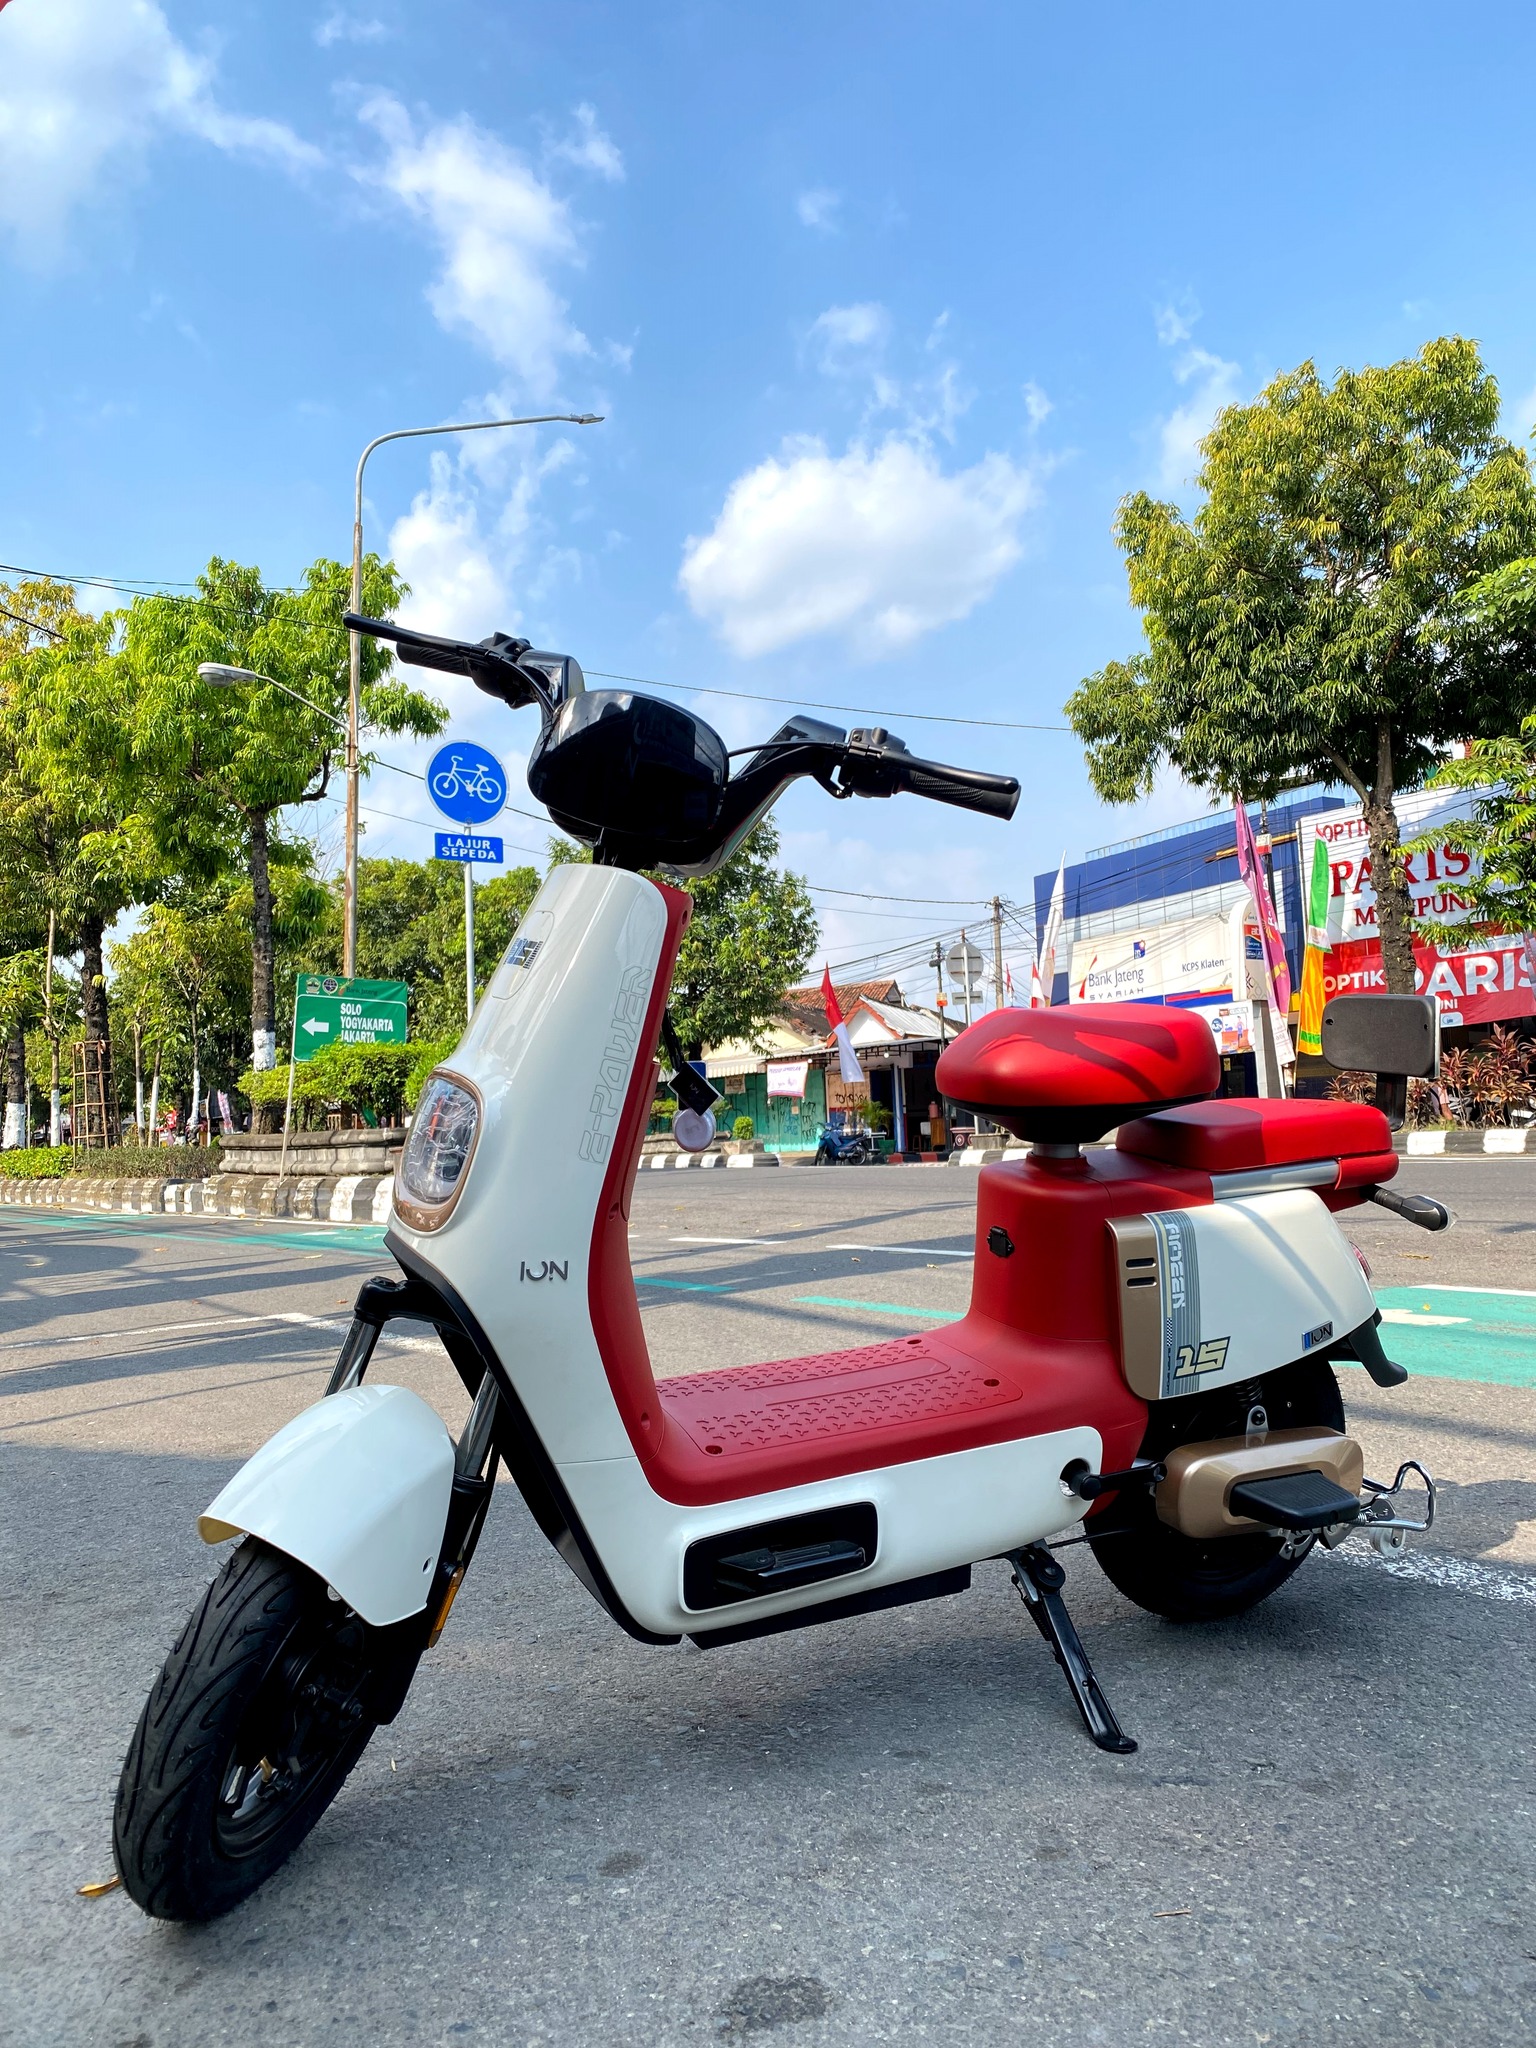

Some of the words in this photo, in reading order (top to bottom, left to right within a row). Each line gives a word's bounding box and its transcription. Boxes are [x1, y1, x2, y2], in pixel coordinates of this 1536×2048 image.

[447, 837, 491, 850] LAJUR
[441, 846, 497, 860] SEPEDA
[1181, 960, 1200, 973] KCPS
[1200, 958, 1225, 970] Klaten
[1088, 970, 1112, 988] Bank
[1113, 968, 1145, 988] Jateng
[1323, 969, 1386, 993] OPTIK
[1414, 952, 1533, 999] ARI
[1089, 986, 1144, 1001] SYARIAH
[340, 1002, 362, 1016] SOLO
[340, 1015, 394, 1032] YOGYAKARTA
[340, 1029, 376, 1043] JAKARTA
[578, 965, 653, 1164] E-POWER
[1172, 1336, 1232, 1380] 15
